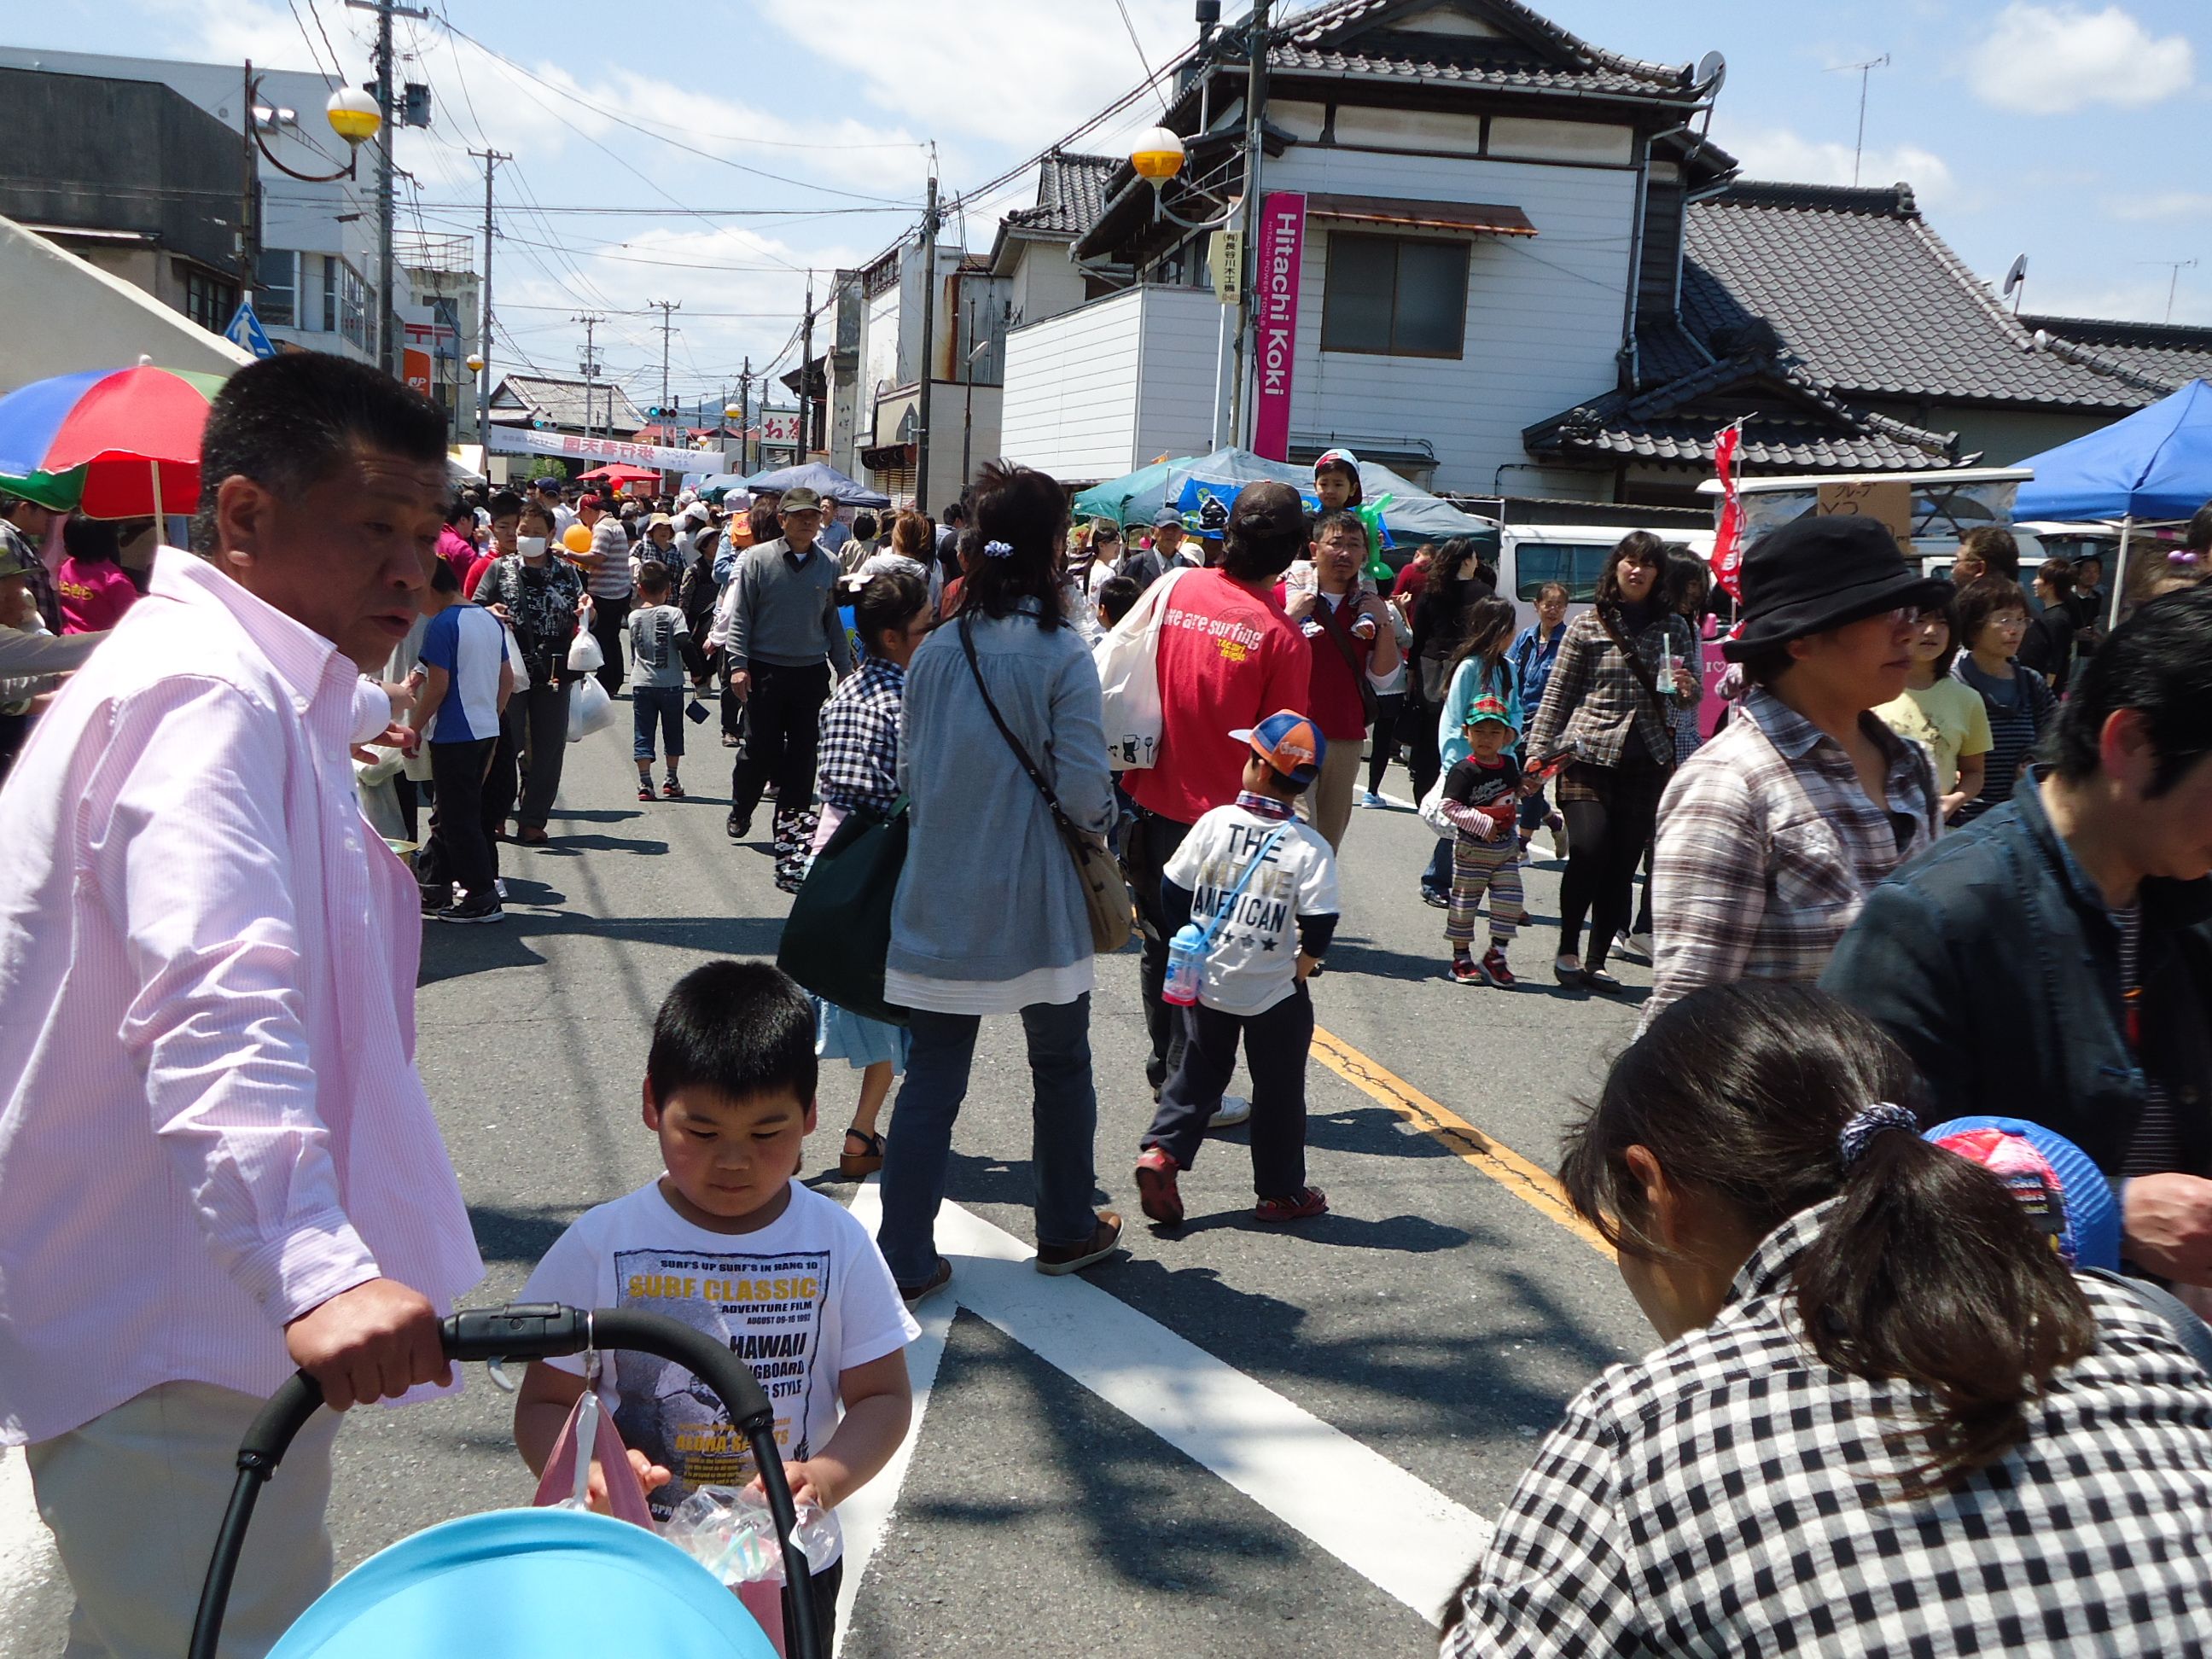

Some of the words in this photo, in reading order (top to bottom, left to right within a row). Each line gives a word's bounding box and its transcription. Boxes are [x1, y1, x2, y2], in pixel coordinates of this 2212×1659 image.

[1270, 213, 1297, 321] Hitachi
[1265, 328, 1289, 396] Koki
[1163, 607, 1182, 626] we
[1182, 613, 1208, 632] are
[1208, 620, 1264, 650] surfing
[1226, 824, 1286, 864] THE
[1198, 859, 1294, 900] NATVE
[661, 1260, 699, 1270] SURF'S
[701, 1260, 717, 1272] UP
[719, 1264, 758, 1272] SURF'S
[760, 1264, 772, 1272] IN
[806, 1260, 818, 1270] 10
[628, 1274, 697, 1299] SURF
[702, 1277, 819, 1302] CLASSIC
[721, 1303, 788, 1314] ADVENTURE
[790, 1301, 812, 1311] FILM
[747, 1316, 775, 1325] AUGUST
[729, 1331, 808, 1359] HAWAII
[772, 1378, 803, 1399] STYLE
[675, 1434, 726, 1453] ALOHA
